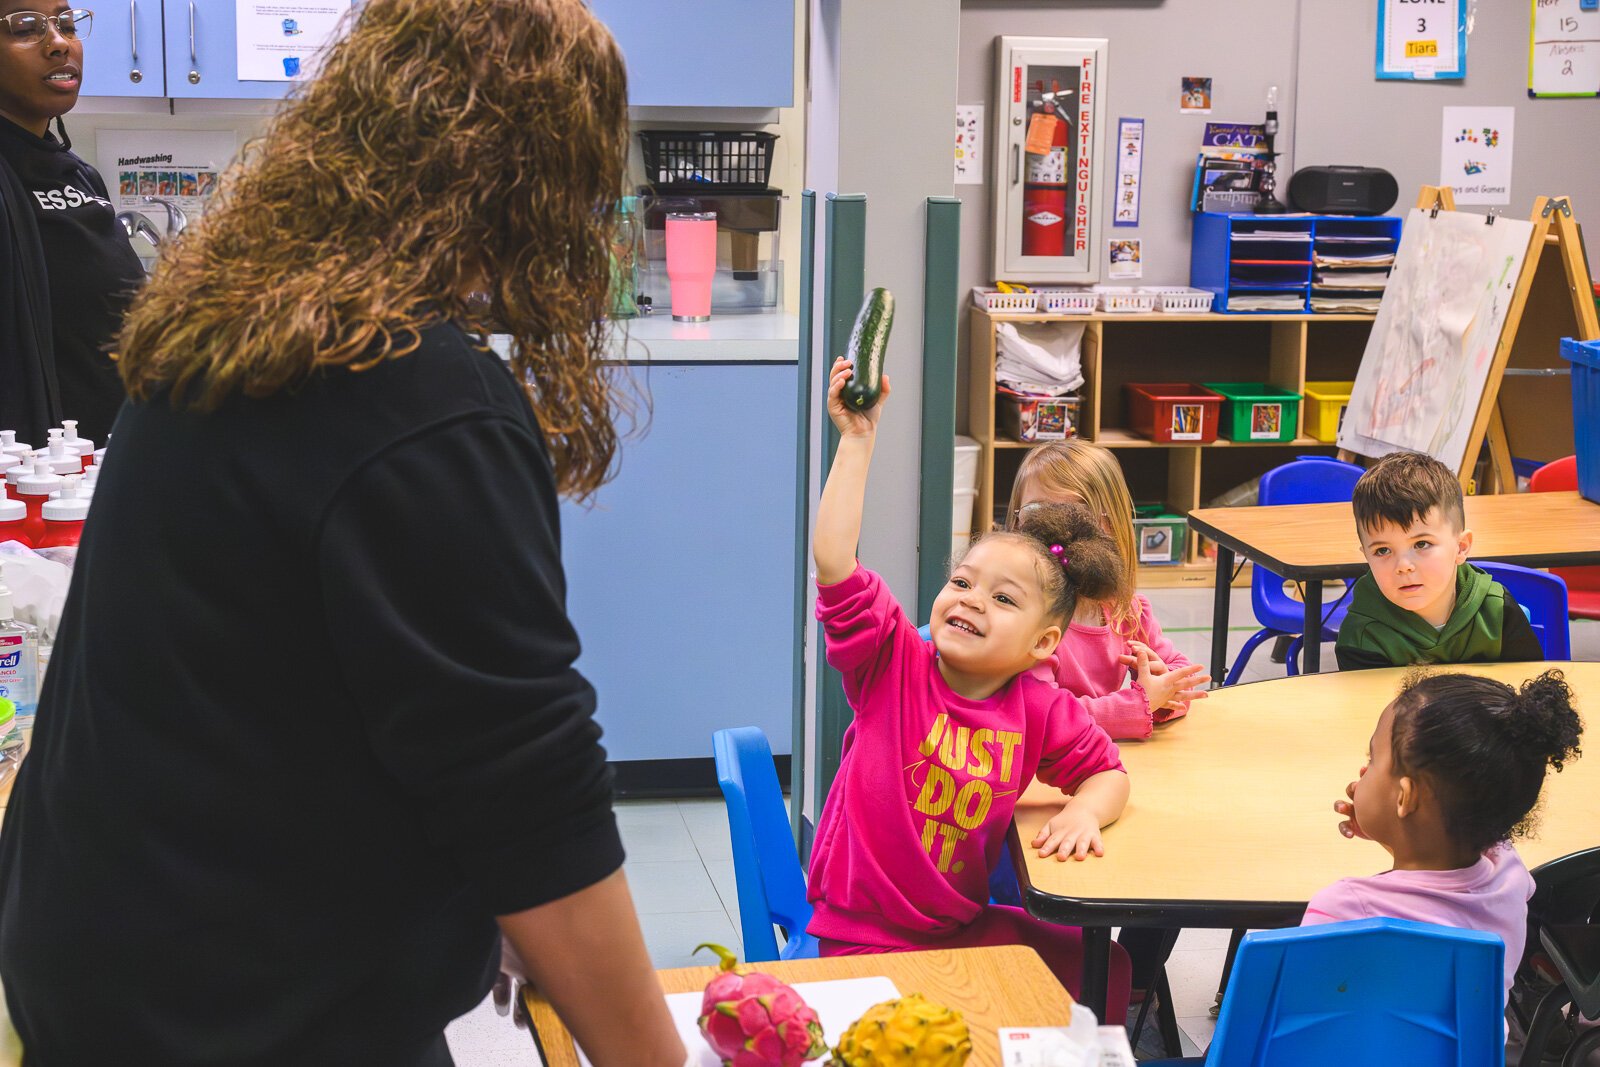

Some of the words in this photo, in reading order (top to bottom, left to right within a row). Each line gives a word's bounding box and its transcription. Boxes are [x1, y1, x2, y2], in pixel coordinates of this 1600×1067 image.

[1417, 18, 1426, 32] 3
[1560, 17, 1578, 32] 15
[1408, 43, 1437, 54] Tiara
[1561, 59, 1573, 75] 2
[1081, 58, 1092, 104] FIRE
[1212, 133, 1264, 147] CAT
[118, 153, 173, 166] Handwashing
[1076, 111, 1090, 251] EXTINGUISHER
[1206, 186, 1261, 207] Sculptur
[1481, 185, 1506, 194] Games
[918, 713, 1023, 783] JUST
[913, 763, 994, 830] DO
